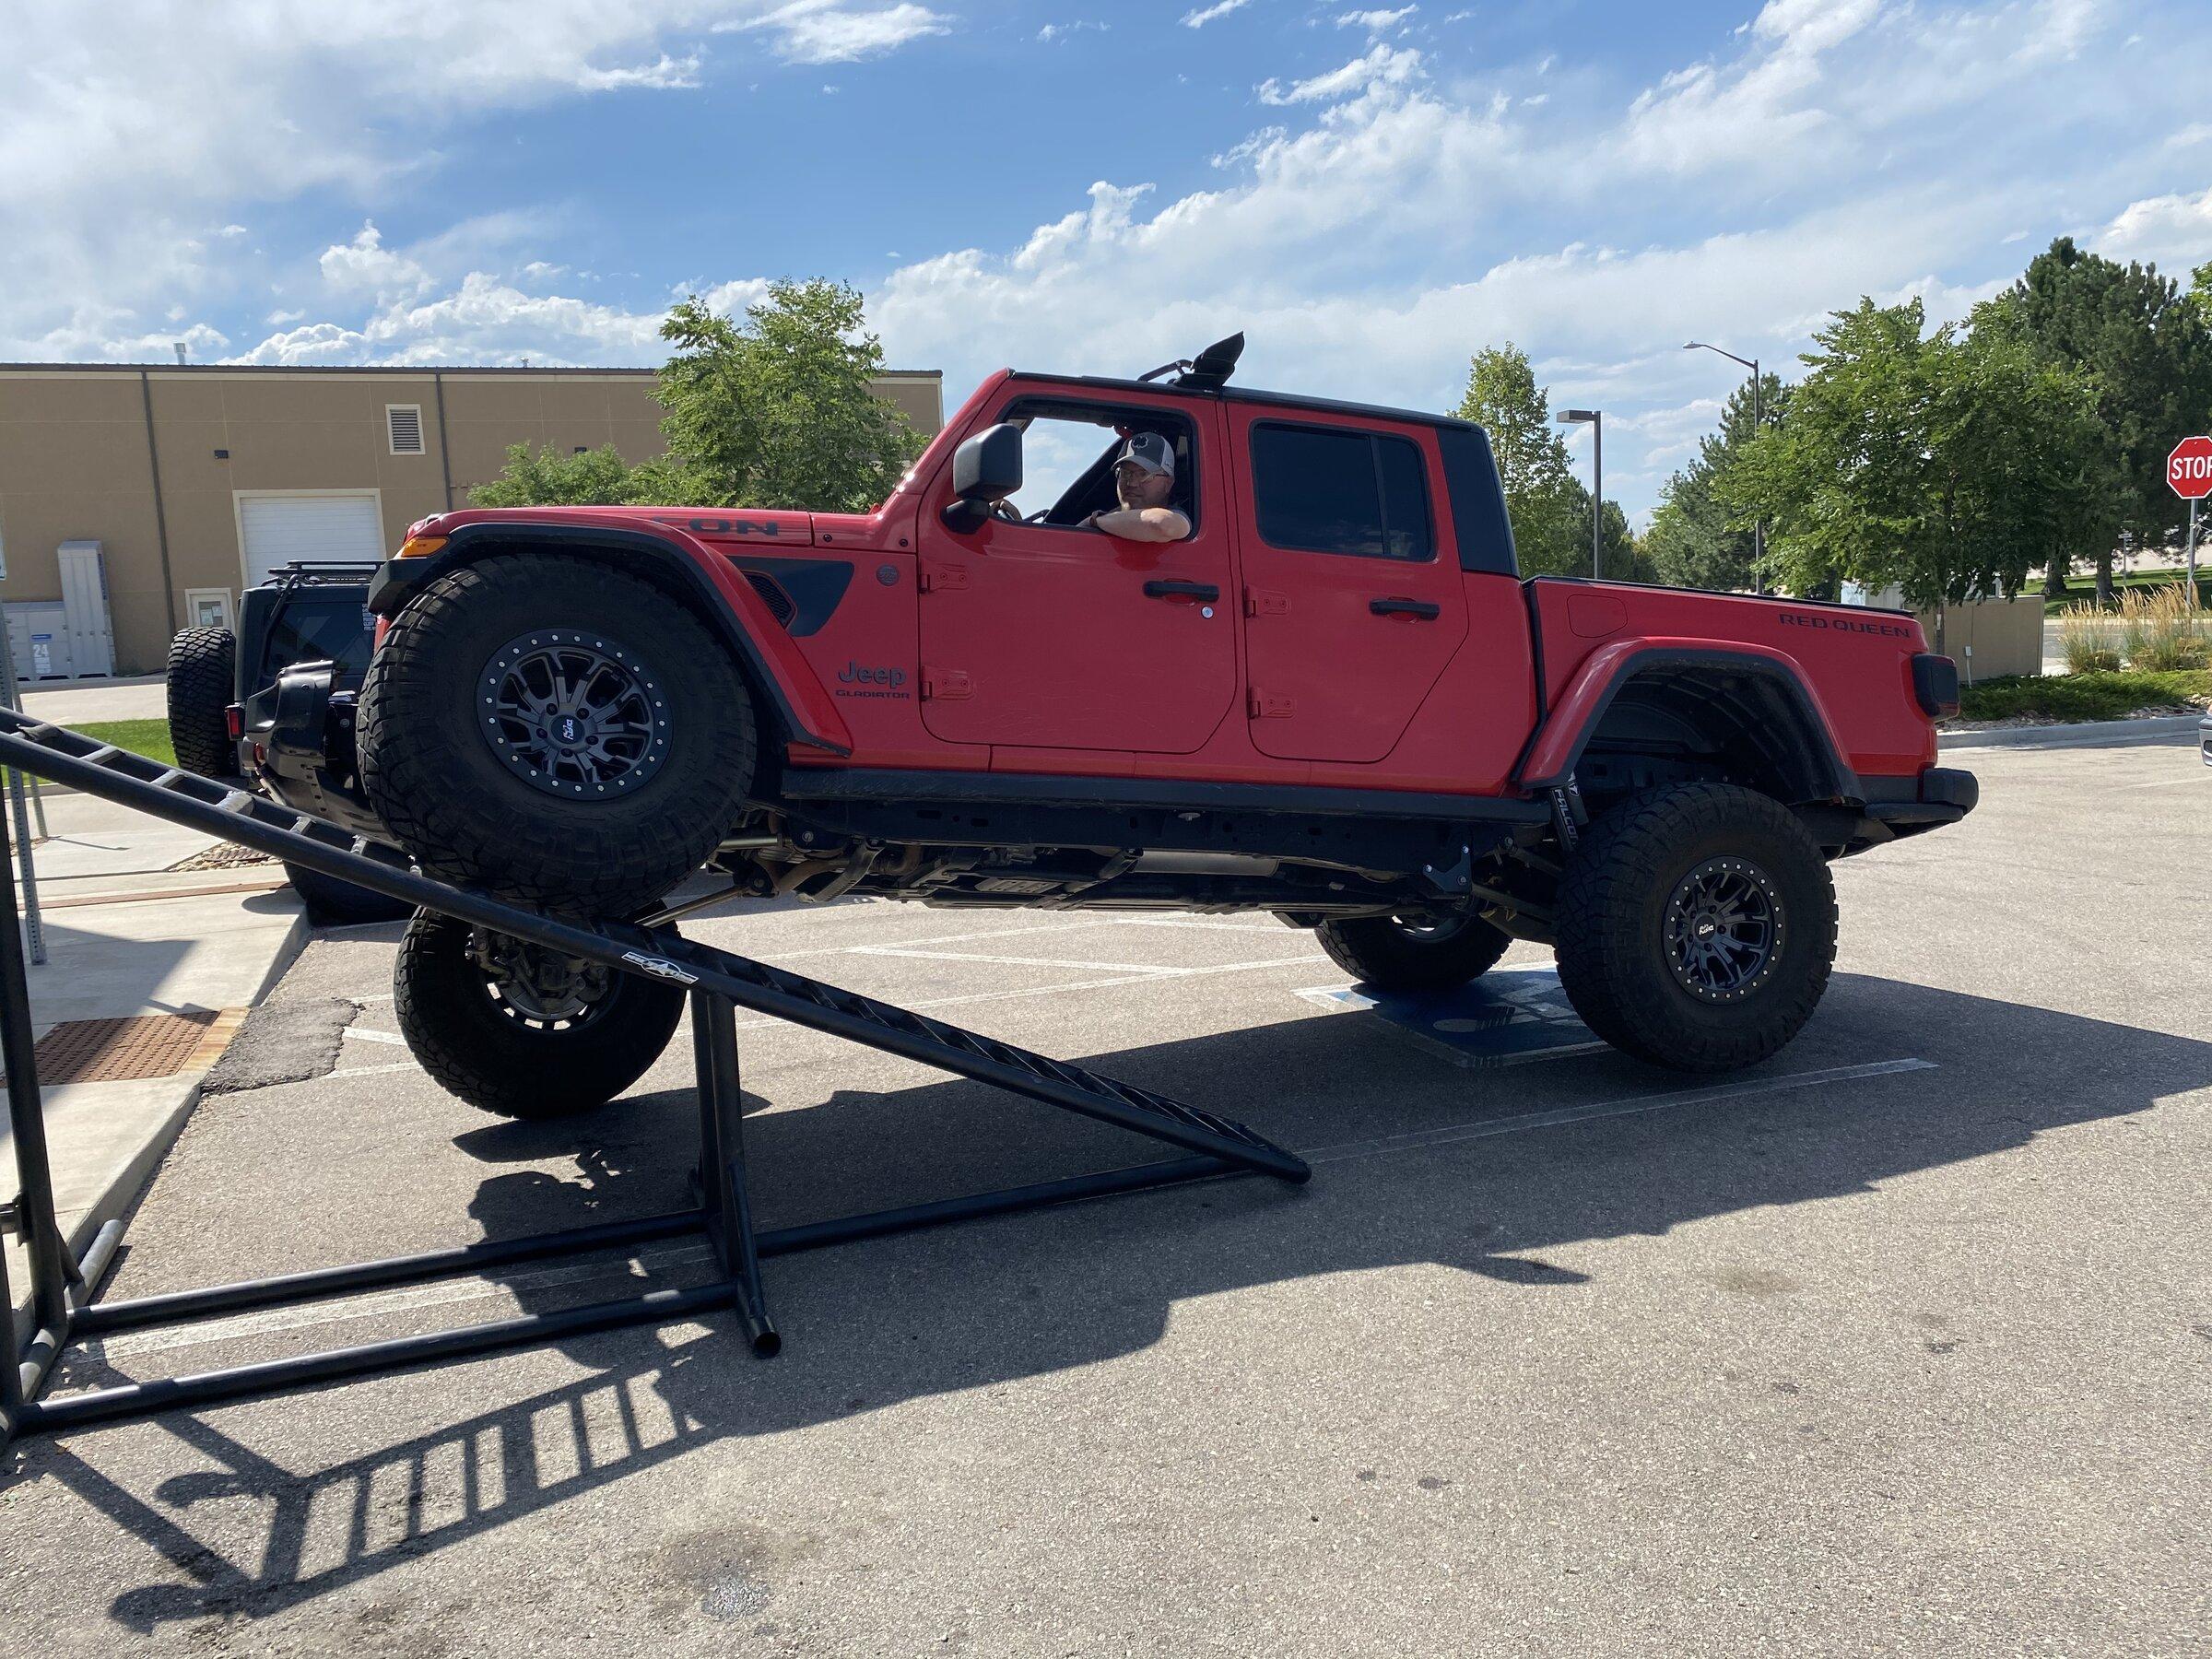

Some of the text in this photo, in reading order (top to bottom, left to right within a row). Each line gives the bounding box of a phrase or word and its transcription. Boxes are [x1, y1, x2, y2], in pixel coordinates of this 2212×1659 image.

[652, 516, 779, 536] ON
[1779, 614, 1911, 638] RED QUEEN
[33, 644, 48, 658] 24
[838, 661, 907, 689] Jeep
[835, 689, 910, 699] GLADIATOR
